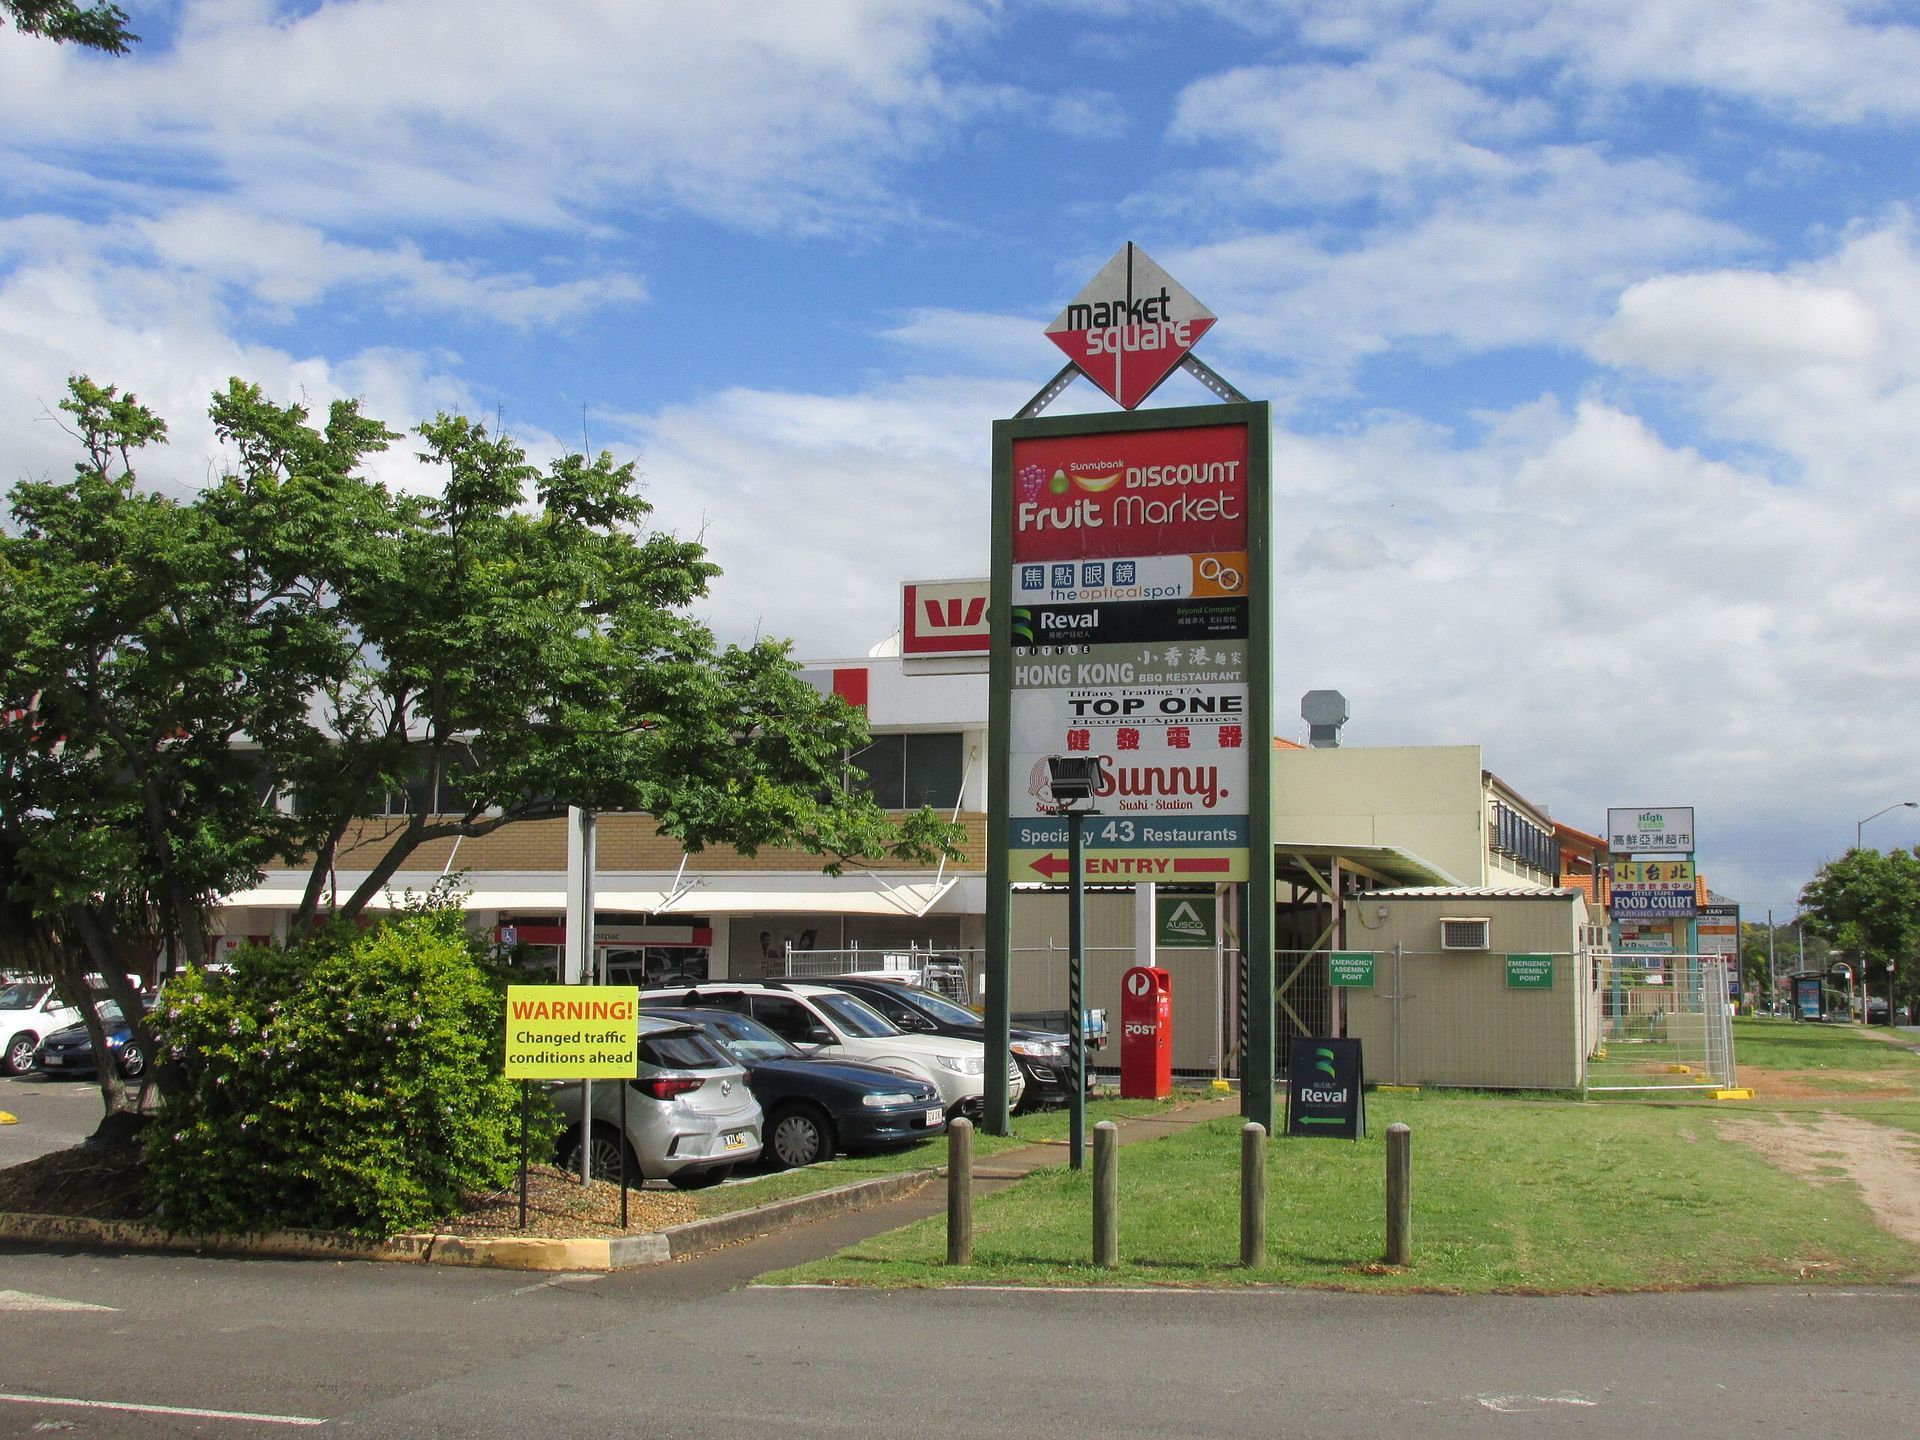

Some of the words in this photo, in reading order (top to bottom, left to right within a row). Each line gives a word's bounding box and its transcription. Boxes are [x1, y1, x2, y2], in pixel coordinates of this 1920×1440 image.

[1070, 460, 1124, 471] Sunnybank
[1126, 461, 1240, 488] DISCOUNT
[1019, 499, 1103, 531] Fruit
[1113, 490, 1240, 526] Market
[1023, 562, 1135, 588] 焦點眼鏡
[1040, 609, 1099, 629] Reval
[1017, 645, 1091, 656] LITTLE
[1015, 664, 1072, 686] HONG
[1077, 662, 1135, 685] KONG
[1138, 673, 1163, 683] BBQ
[1166, 671, 1242, 683] RESTAURANT
[1067, 690, 1116, 699] Tiffany
[1119, 688, 1174, 697] Trading
[1176, 687, 1203, 695] T/A
[1068, 698, 1145, 716] TOP
[1159, 696, 1243, 714] ONE
[1149, 716, 1239, 724] Appliances
[1067, 725, 1243, 751] 健發電器
[1119, 799, 1149, 811] Sushi
[1155, 798, 1194, 811] Station
[1638, 812, 1663, 823] High
[1101, 821, 1136, 842] 43
[1143, 828, 1238, 842] Restaurants
[1085, 858, 1170, 874] ENTRY
[1617, 863, 1689, 881] 小台北
[1614, 896, 1648, 909] FOOD
[1650, 896, 1692, 909] COURT
[1614, 910, 1653, 918] PARKING
[1166, 921, 1204, 929] AUSCO
[512, 1001, 633, 1020] WARNING!
[1125, 1025, 1157, 1036] POST
[516, 1031, 581, 1046] Changed
[584, 1031, 627, 1044] traffic
[509, 1051, 585, 1064] conditions
[588, 1051, 633, 1064] ahead
[1301, 1088, 1348, 1103] Reval
